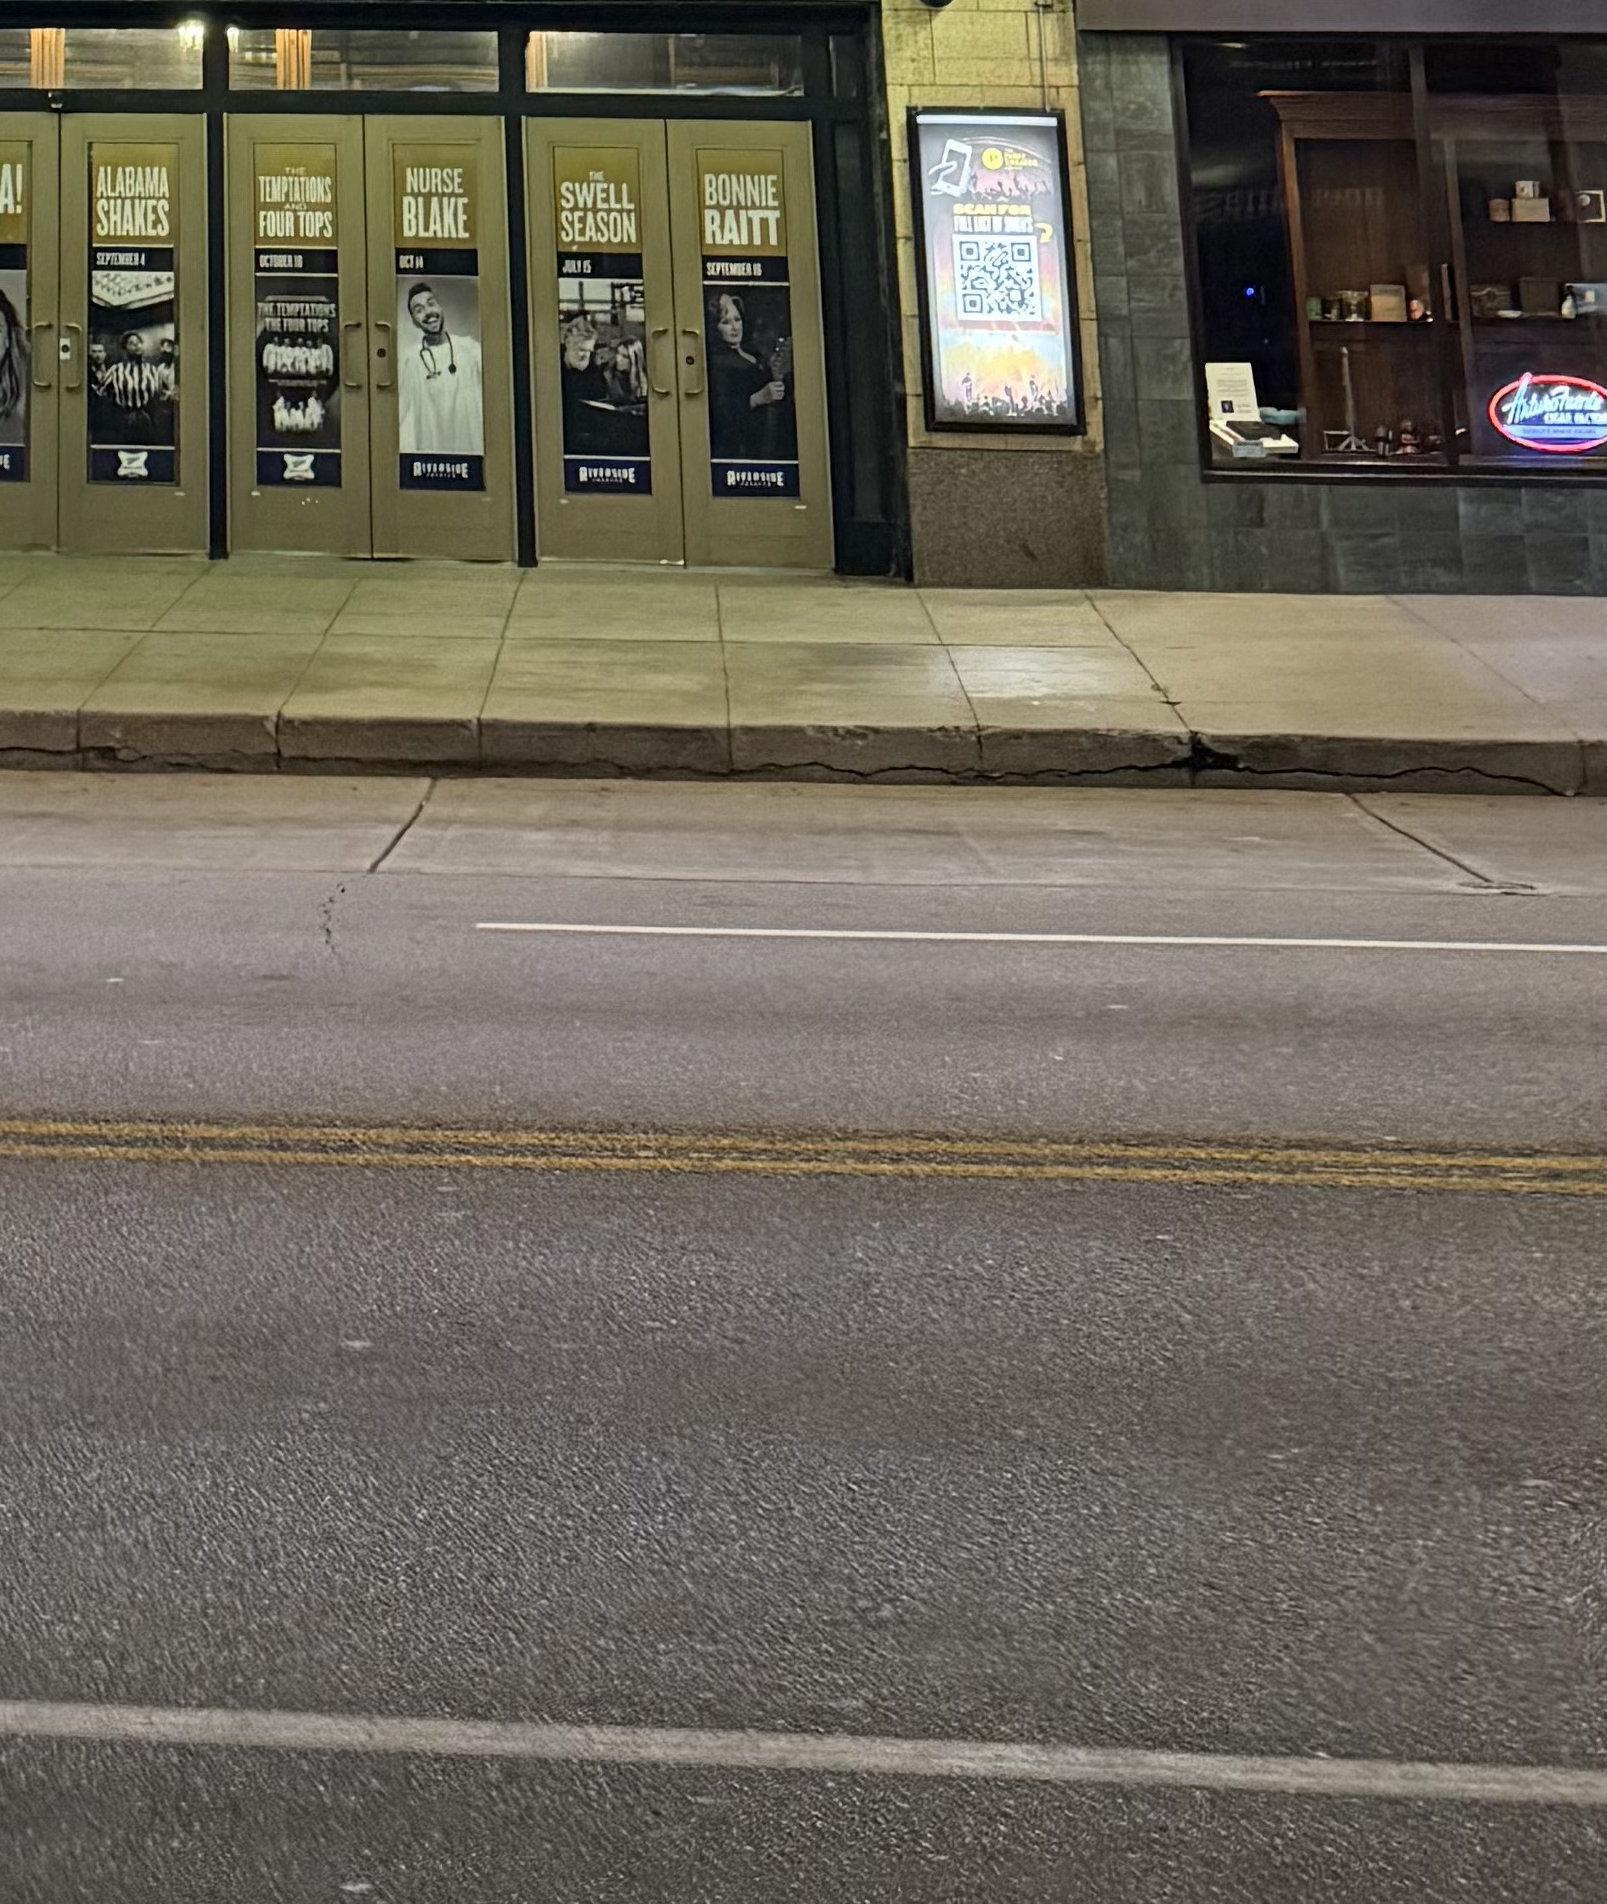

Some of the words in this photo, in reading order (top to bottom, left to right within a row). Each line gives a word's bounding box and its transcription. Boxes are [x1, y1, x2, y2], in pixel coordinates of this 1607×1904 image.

[96, 166, 170, 198] ALABAMA
[284, 167, 306, 175] THE
[405, 167, 464, 193] NURSE
[589, 170, 604, 181] THE
[258, 175, 332, 203] TEMPTATIONS
[560, 181, 635, 210] SWELL
[704, 173, 779, 207] BONNIE
[96, 198, 170, 237] SHAKES
[259, 210, 295, 238] FOUR
[296, 210, 333, 238] TOPS
[402, 195, 470, 238] BLAKE
[560, 210, 637, 243] SEASON
[704, 208, 781, 246] RAITT
[96, 252, 138, 266] SEPTEMBER
[399, 254, 414, 268] OCT
[562, 260, 582, 274] JULY
[706, 262, 751, 277] SEPTEMBER
